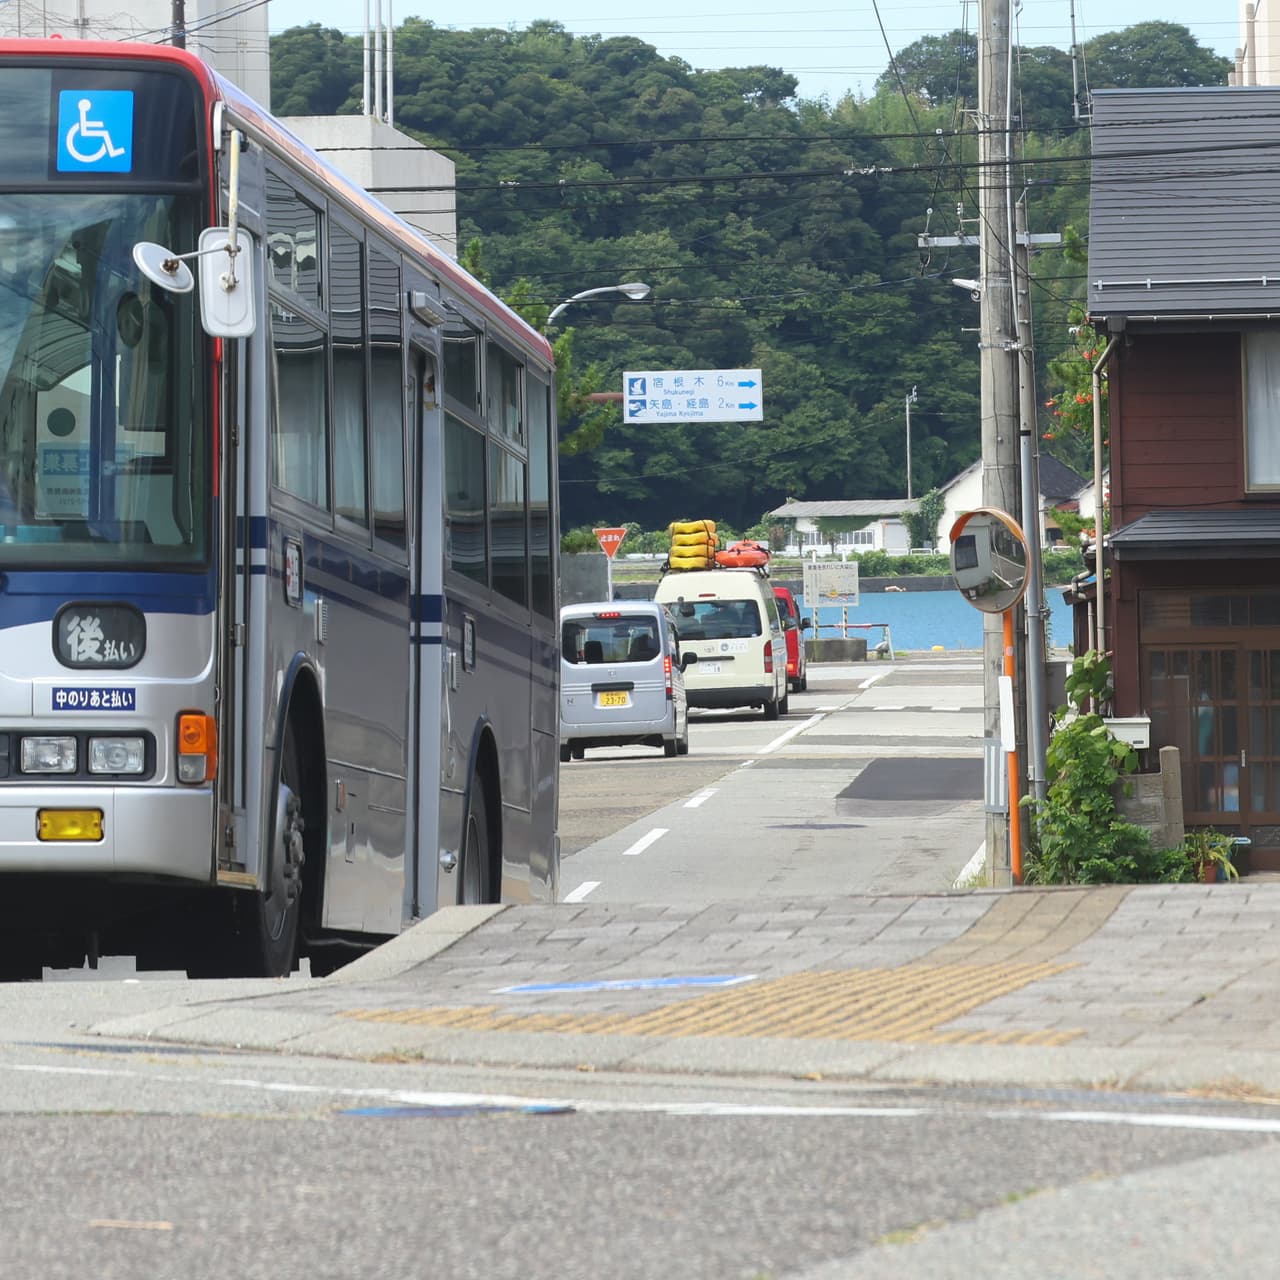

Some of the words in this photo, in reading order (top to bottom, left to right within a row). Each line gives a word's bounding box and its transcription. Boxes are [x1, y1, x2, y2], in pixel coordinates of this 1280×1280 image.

[652, 376, 705, 389] 宿根木
[67, 615, 135, 662] 後払い
[56, 688, 133, 708] 中のりあと払い
